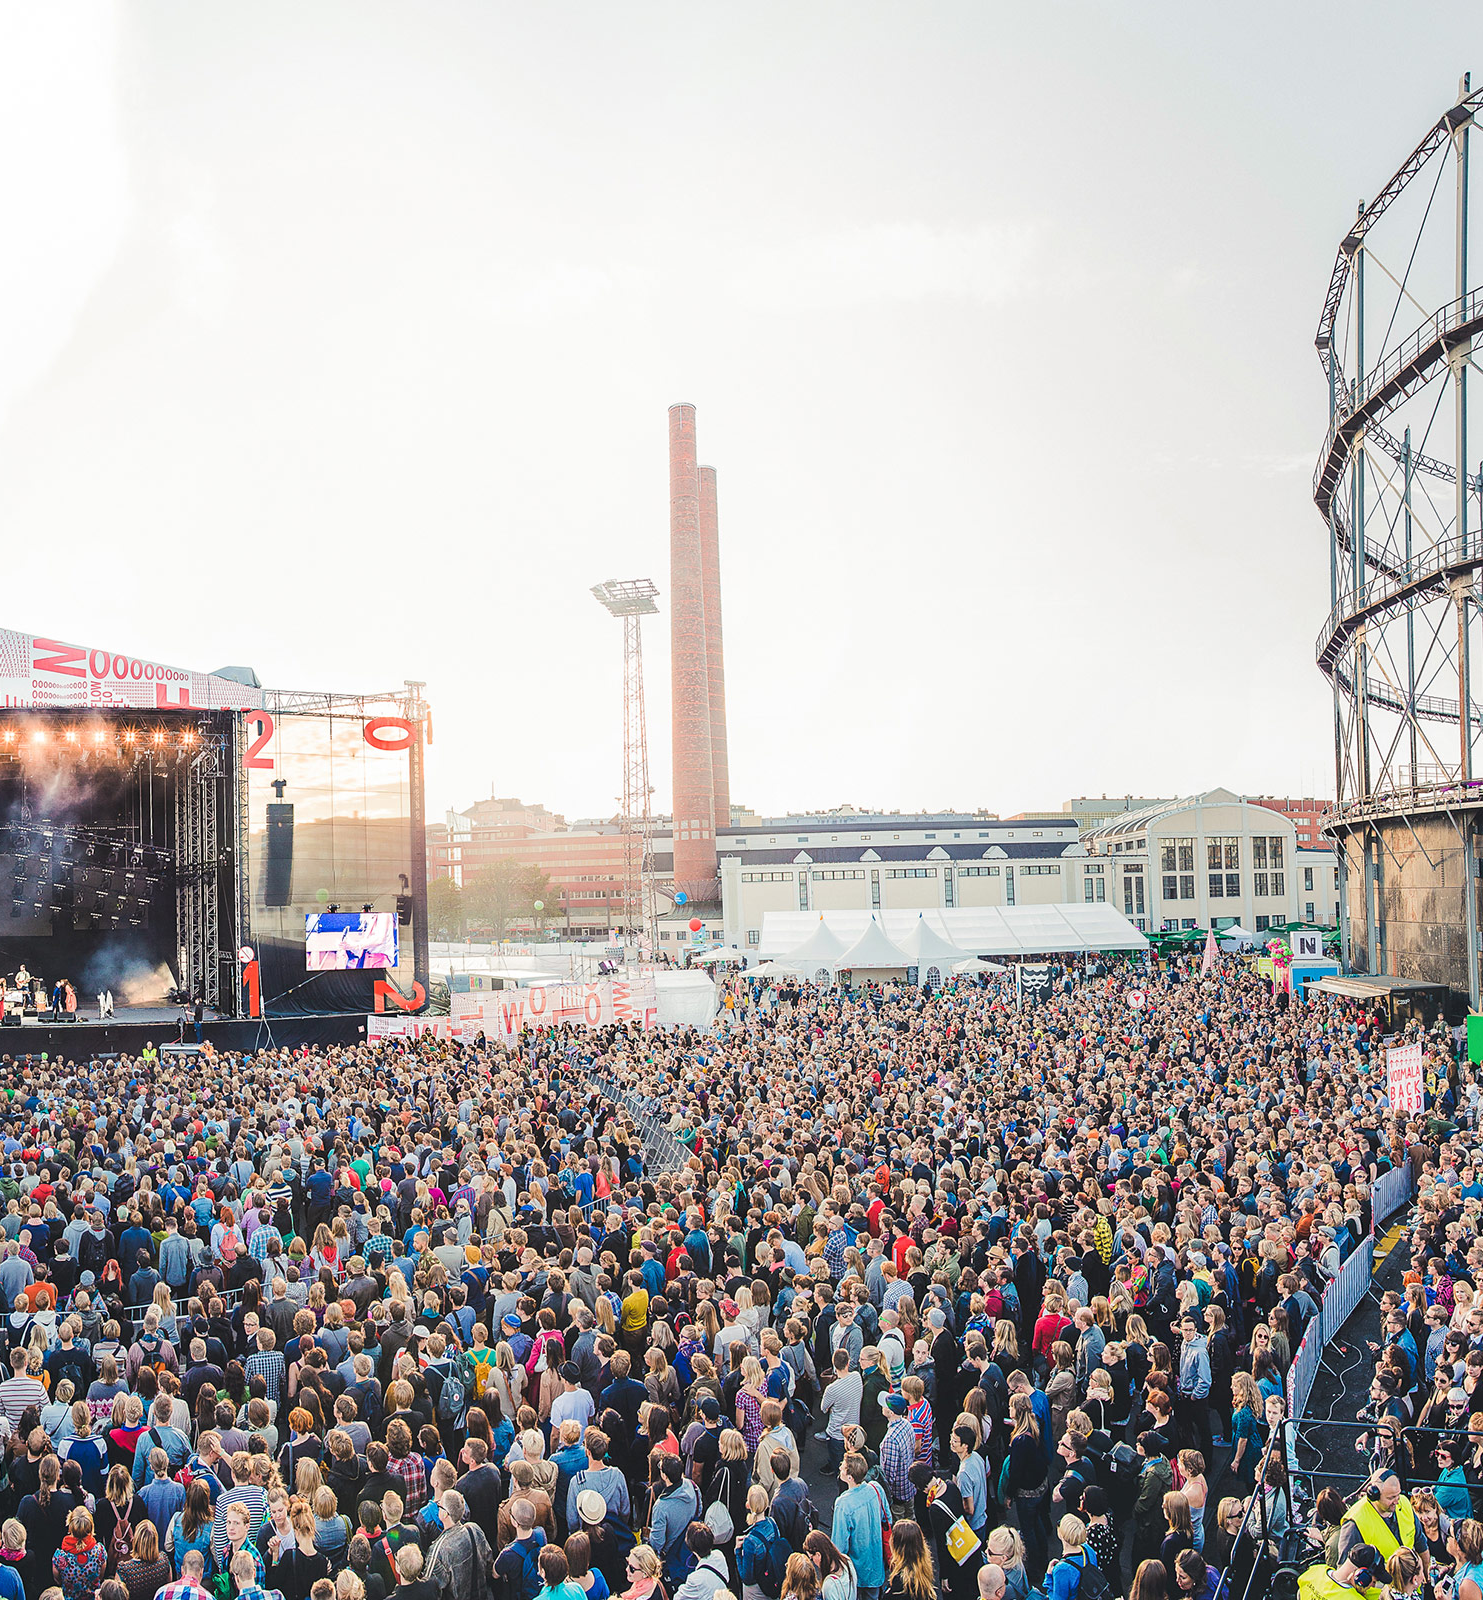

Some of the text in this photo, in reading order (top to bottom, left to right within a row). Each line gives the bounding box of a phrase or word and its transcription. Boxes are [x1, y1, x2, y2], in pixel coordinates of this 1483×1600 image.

[242, 710, 274, 769] 2
[1299, 937, 1317, 955] N
[243, 961, 259, 1017] 1
[374, 980, 426, 1014] 2
[502, 1002, 525, 1034] W
[585, 992, 601, 1026] O
[1390, 1065, 1420, 1083] VOIMALA
[1390, 1080, 1421, 1100] BACK
[1390, 1095, 1422, 1111] YARD
